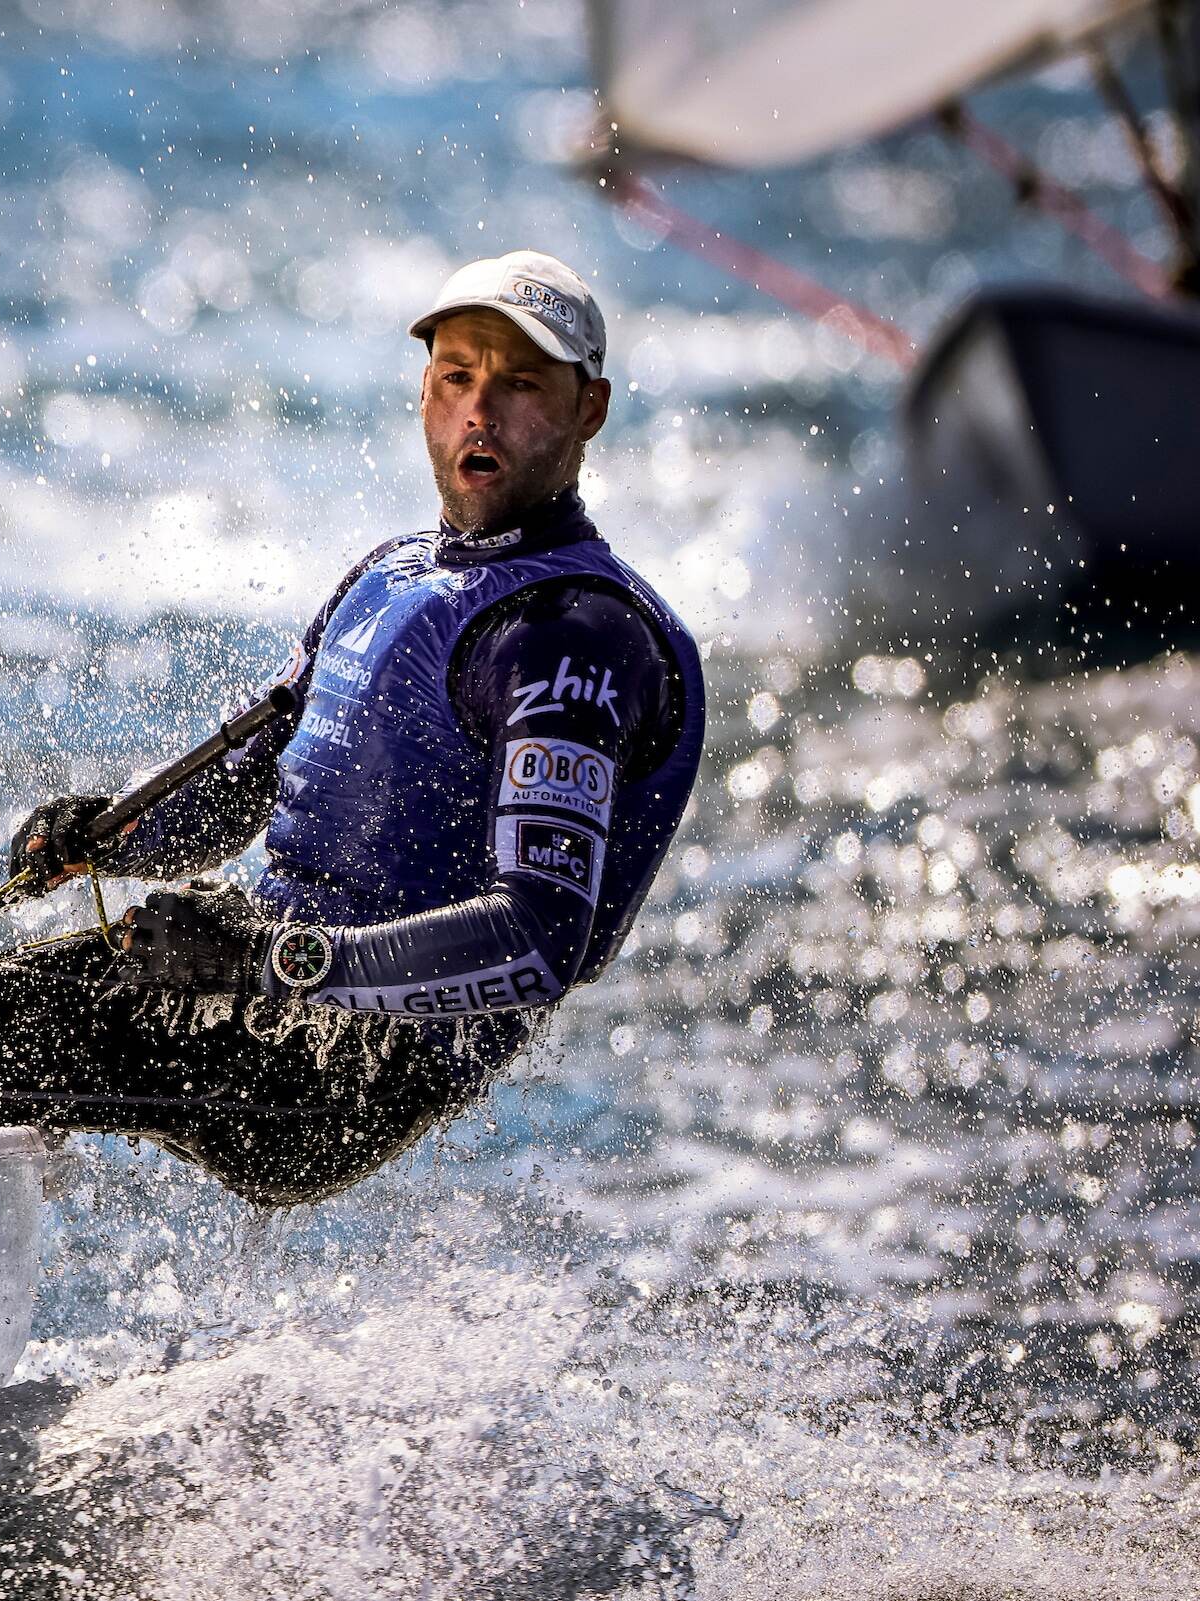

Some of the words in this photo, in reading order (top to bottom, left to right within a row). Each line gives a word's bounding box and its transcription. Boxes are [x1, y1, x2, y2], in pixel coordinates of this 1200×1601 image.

[524, 285, 567, 317] BBS
[522, 753, 599, 792] BBS
[512, 791, 602, 818] AUTOMATION
[528, 845, 585, 877] MPC
